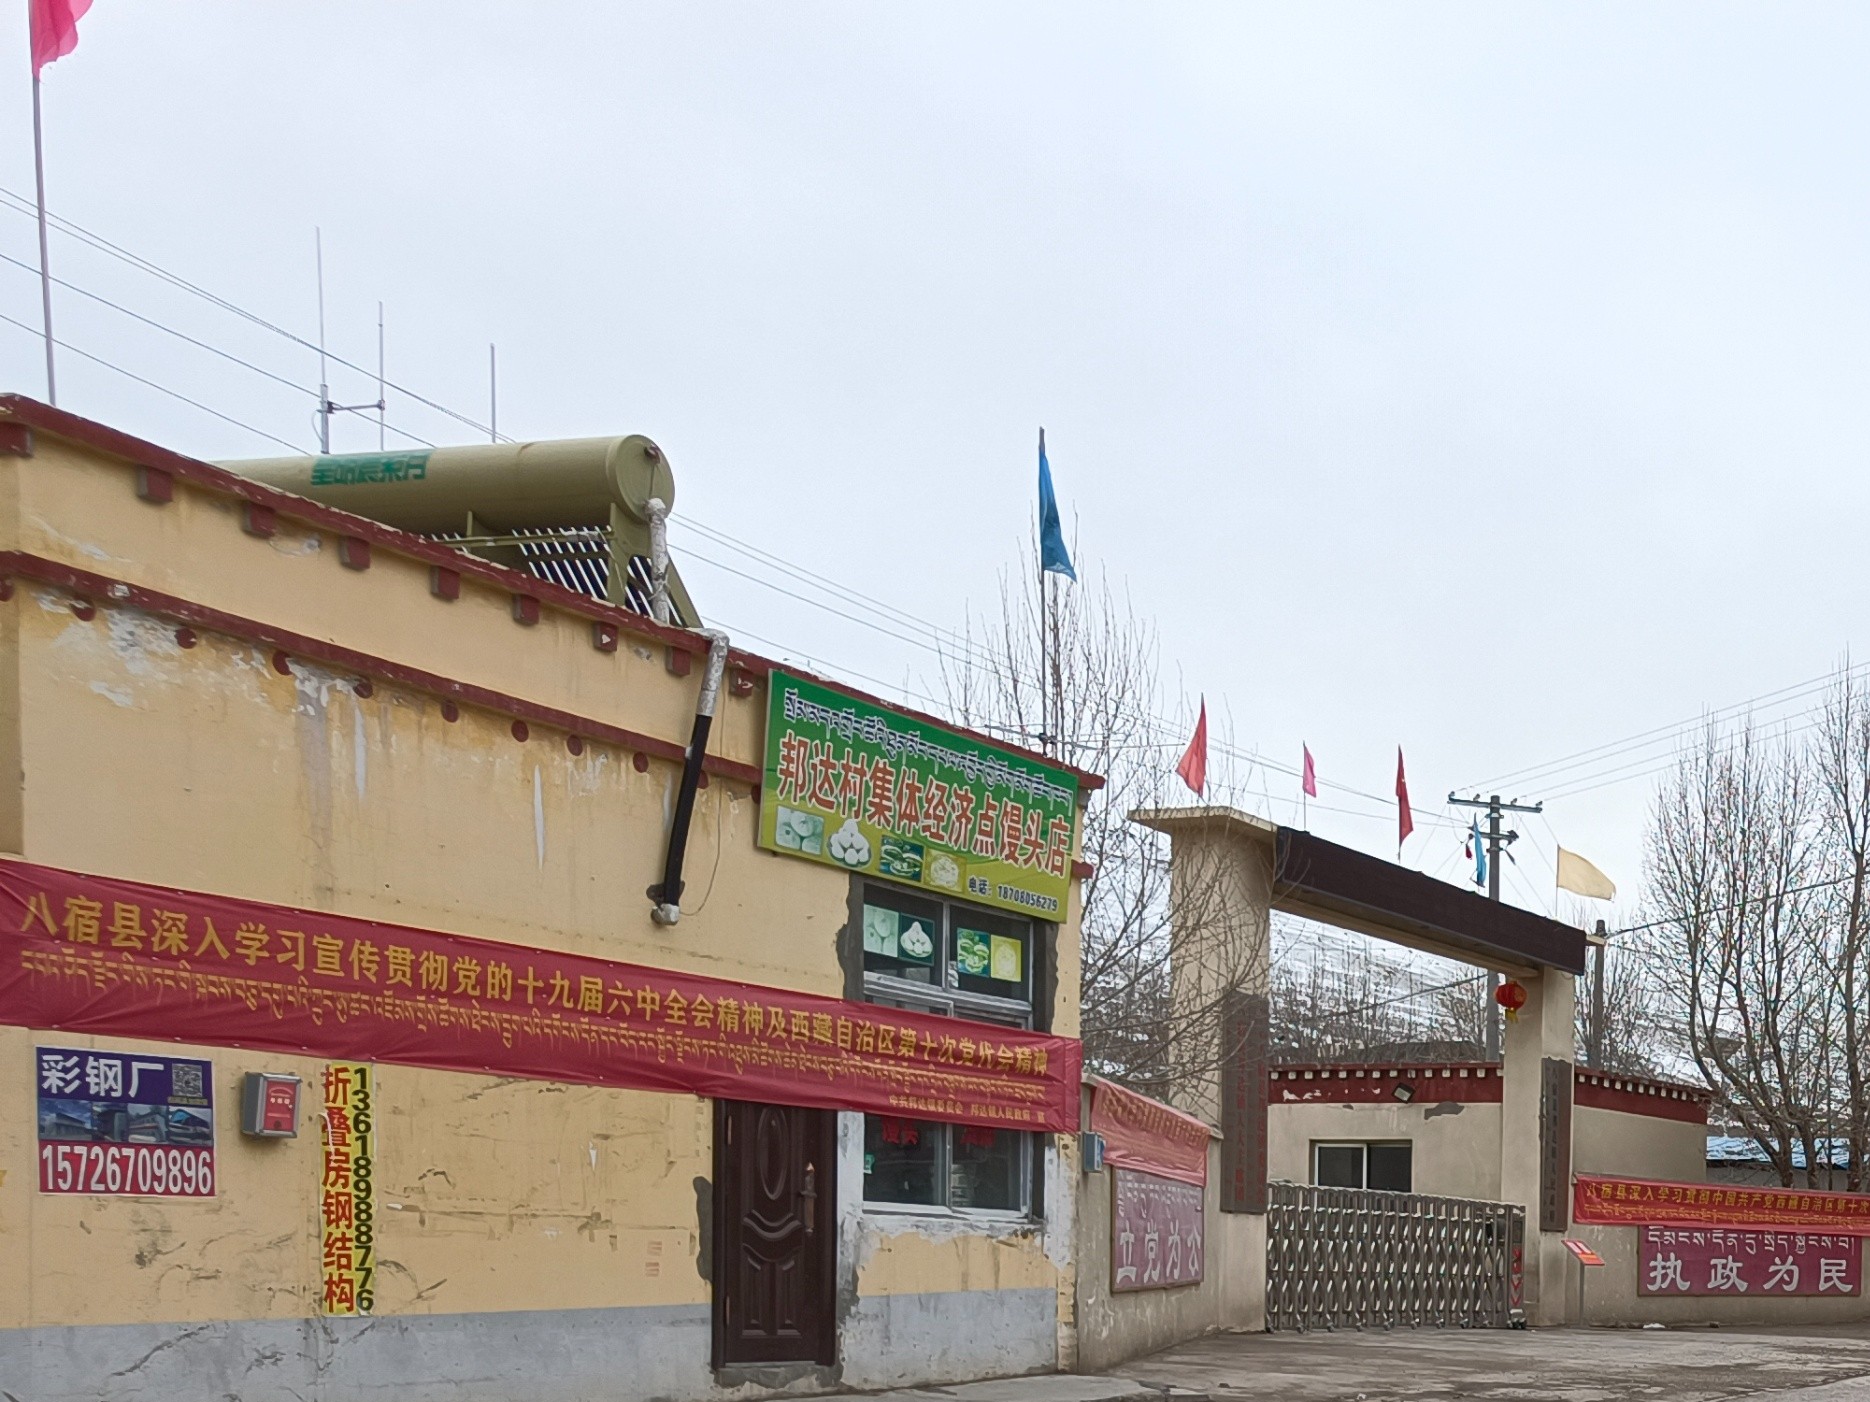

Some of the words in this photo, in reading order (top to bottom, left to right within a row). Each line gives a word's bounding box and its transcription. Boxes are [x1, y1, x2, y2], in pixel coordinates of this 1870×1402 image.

[776, 729, 1071, 879] 邦达村集体经济点馒头店
[20, 891, 1049, 1077] 八宿县深入学习宣传贯彻党的十九届六中全会精神及西藏自治区第十次党代会精神
[41, 1054, 165, 1098] 彩钢厂
[42, 1144, 212, 1195] 15726709896
[321, 1066, 355, 1314] 折叠房钢结构
[352, 1067, 374, 1312] 13618988776
[1116, 1218, 1202, 1284] 立党为公
[1646, 1252, 1854, 1293] 执政为民
